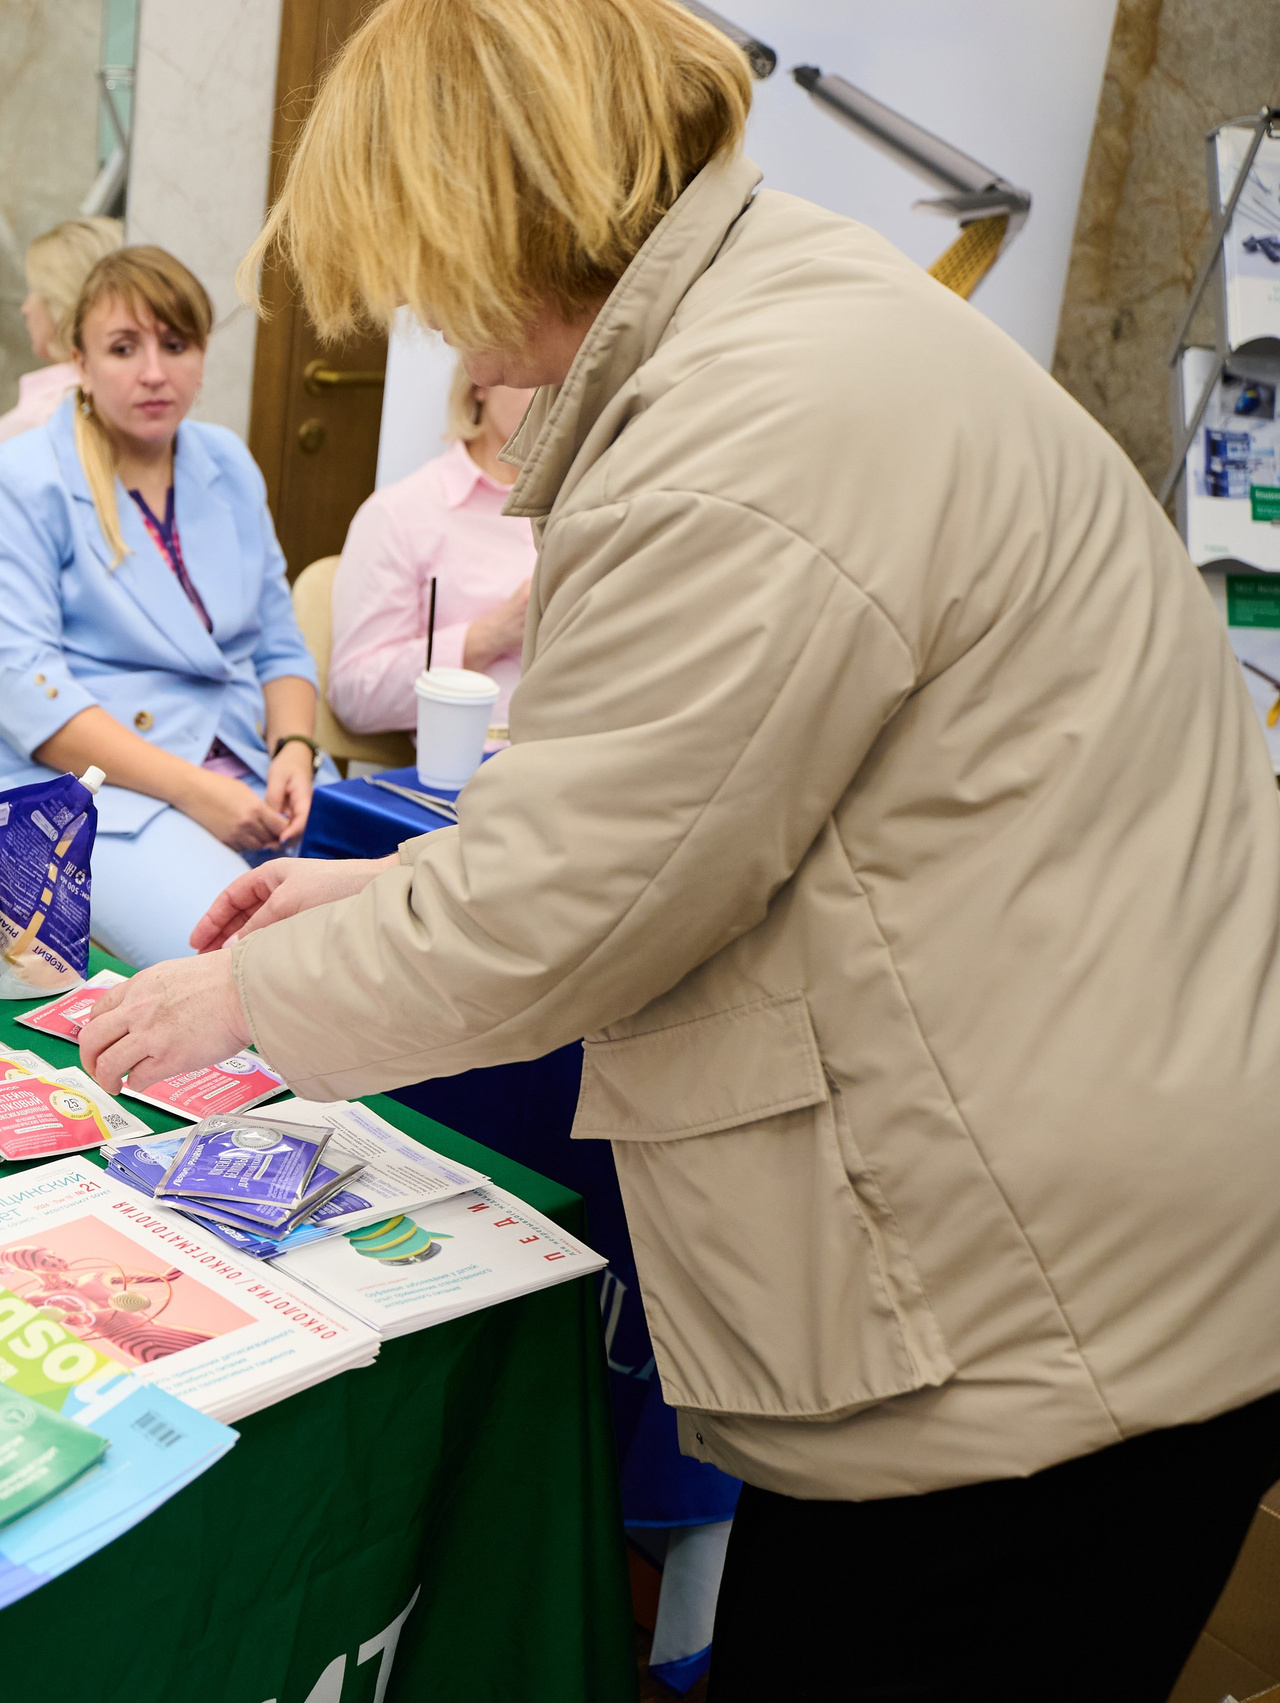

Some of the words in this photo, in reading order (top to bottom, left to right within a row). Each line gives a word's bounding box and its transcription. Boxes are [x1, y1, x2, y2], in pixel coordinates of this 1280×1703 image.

[67, 882, 79, 895] 500
[31, 945, 68, 974] ЛЕОВИТ
[63, 1098, 79, 1109] 25
[6, 1215, 38, 1229] COUNCIL
[43, 1196, 89, 1216] MEDITSINSKIY
[91, 1189, 112, 1199] SOVET
[112, 1201, 242, 1280] ОНКОГЕМАТОЛОГИЯ
[247, 1284, 338, 1340] ОНКОЛОГИЯ
